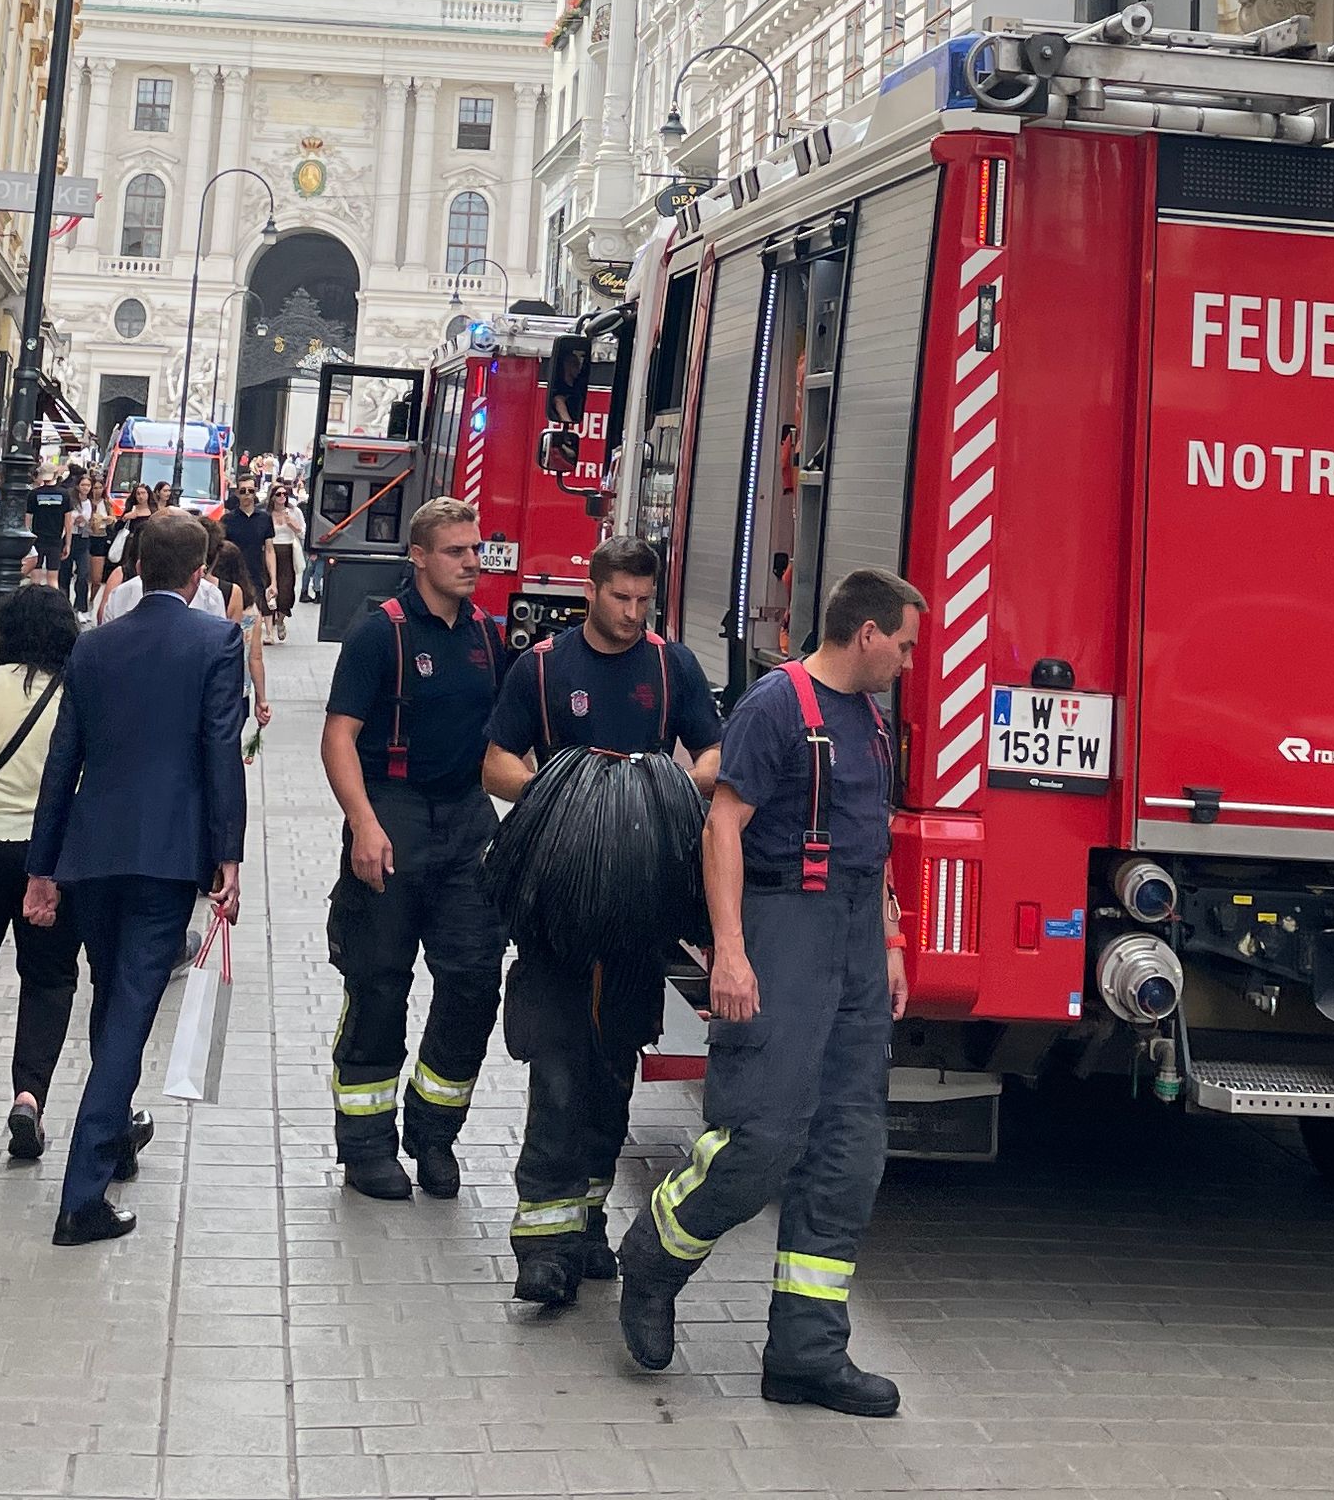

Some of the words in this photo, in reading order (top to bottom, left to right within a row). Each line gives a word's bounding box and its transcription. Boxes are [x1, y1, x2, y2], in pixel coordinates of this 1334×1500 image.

[1031, 696, 1054, 730] W
[998, 729, 1050, 766] 153
[1056, 734, 1101, 770] FW
